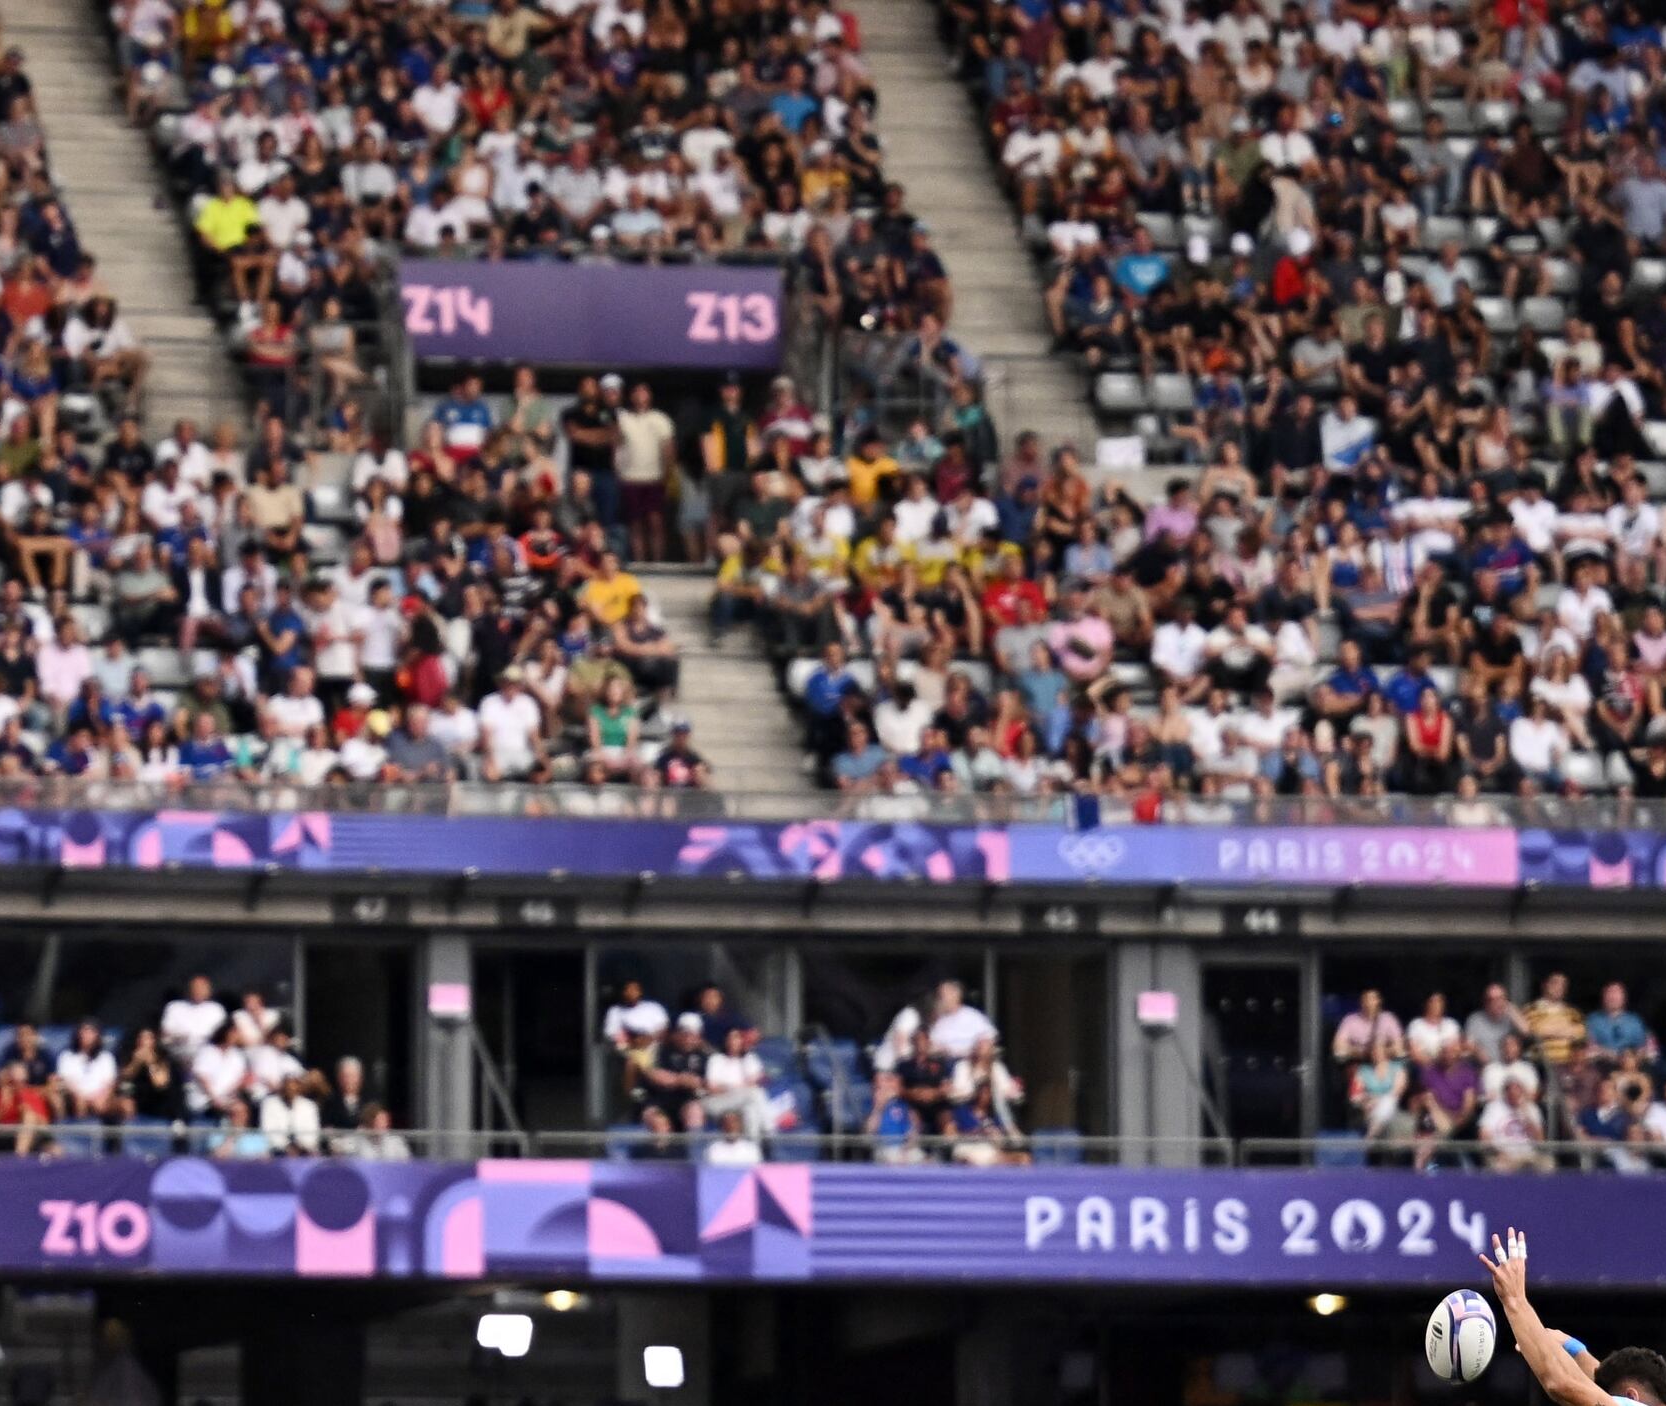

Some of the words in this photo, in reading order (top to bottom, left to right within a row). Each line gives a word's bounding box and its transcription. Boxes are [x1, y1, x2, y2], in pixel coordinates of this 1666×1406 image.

[400, 284, 492, 337] Z14
[686, 292, 778, 343] Z13
[1218, 838, 1345, 874] PARIS
[1359, 839, 1476, 875] 2024
[39, 1200, 151, 1258] Z10
[1024, 1196, 1251, 1256] PARIS
[1280, 1198, 1488, 1257] 2024
